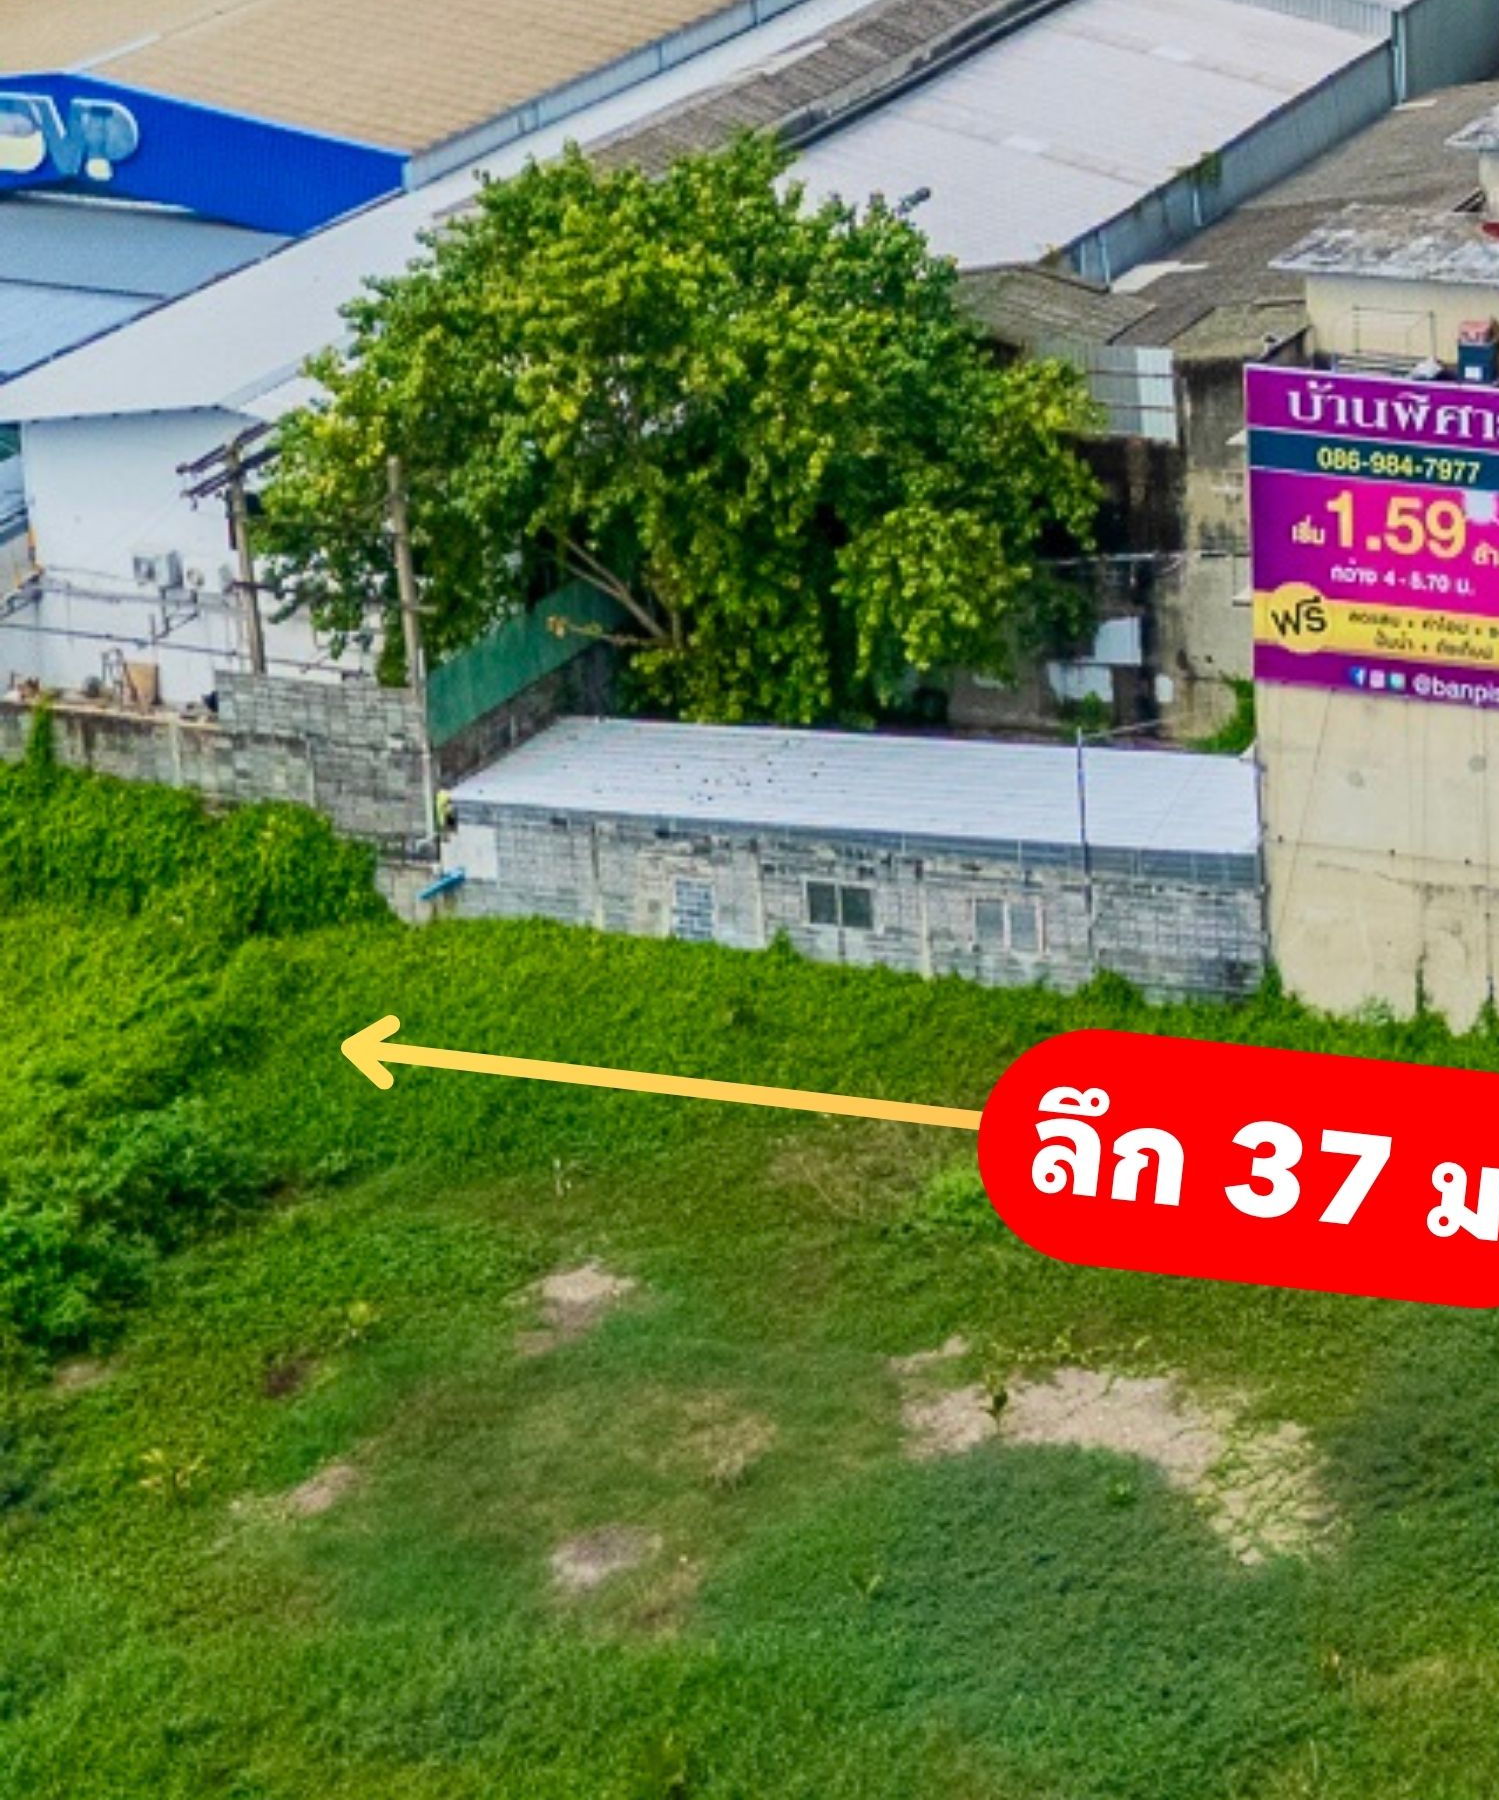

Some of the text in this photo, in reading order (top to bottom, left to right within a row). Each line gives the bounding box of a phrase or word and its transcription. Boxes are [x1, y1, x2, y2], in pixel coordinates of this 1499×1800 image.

[1317, 447, 1480, 483] 086-984-7977
[1326, 490, 1466, 559] 1.59
[1383, 570, 1396, 586] 4
[1271, 596, 1328, 636] ฟรี
